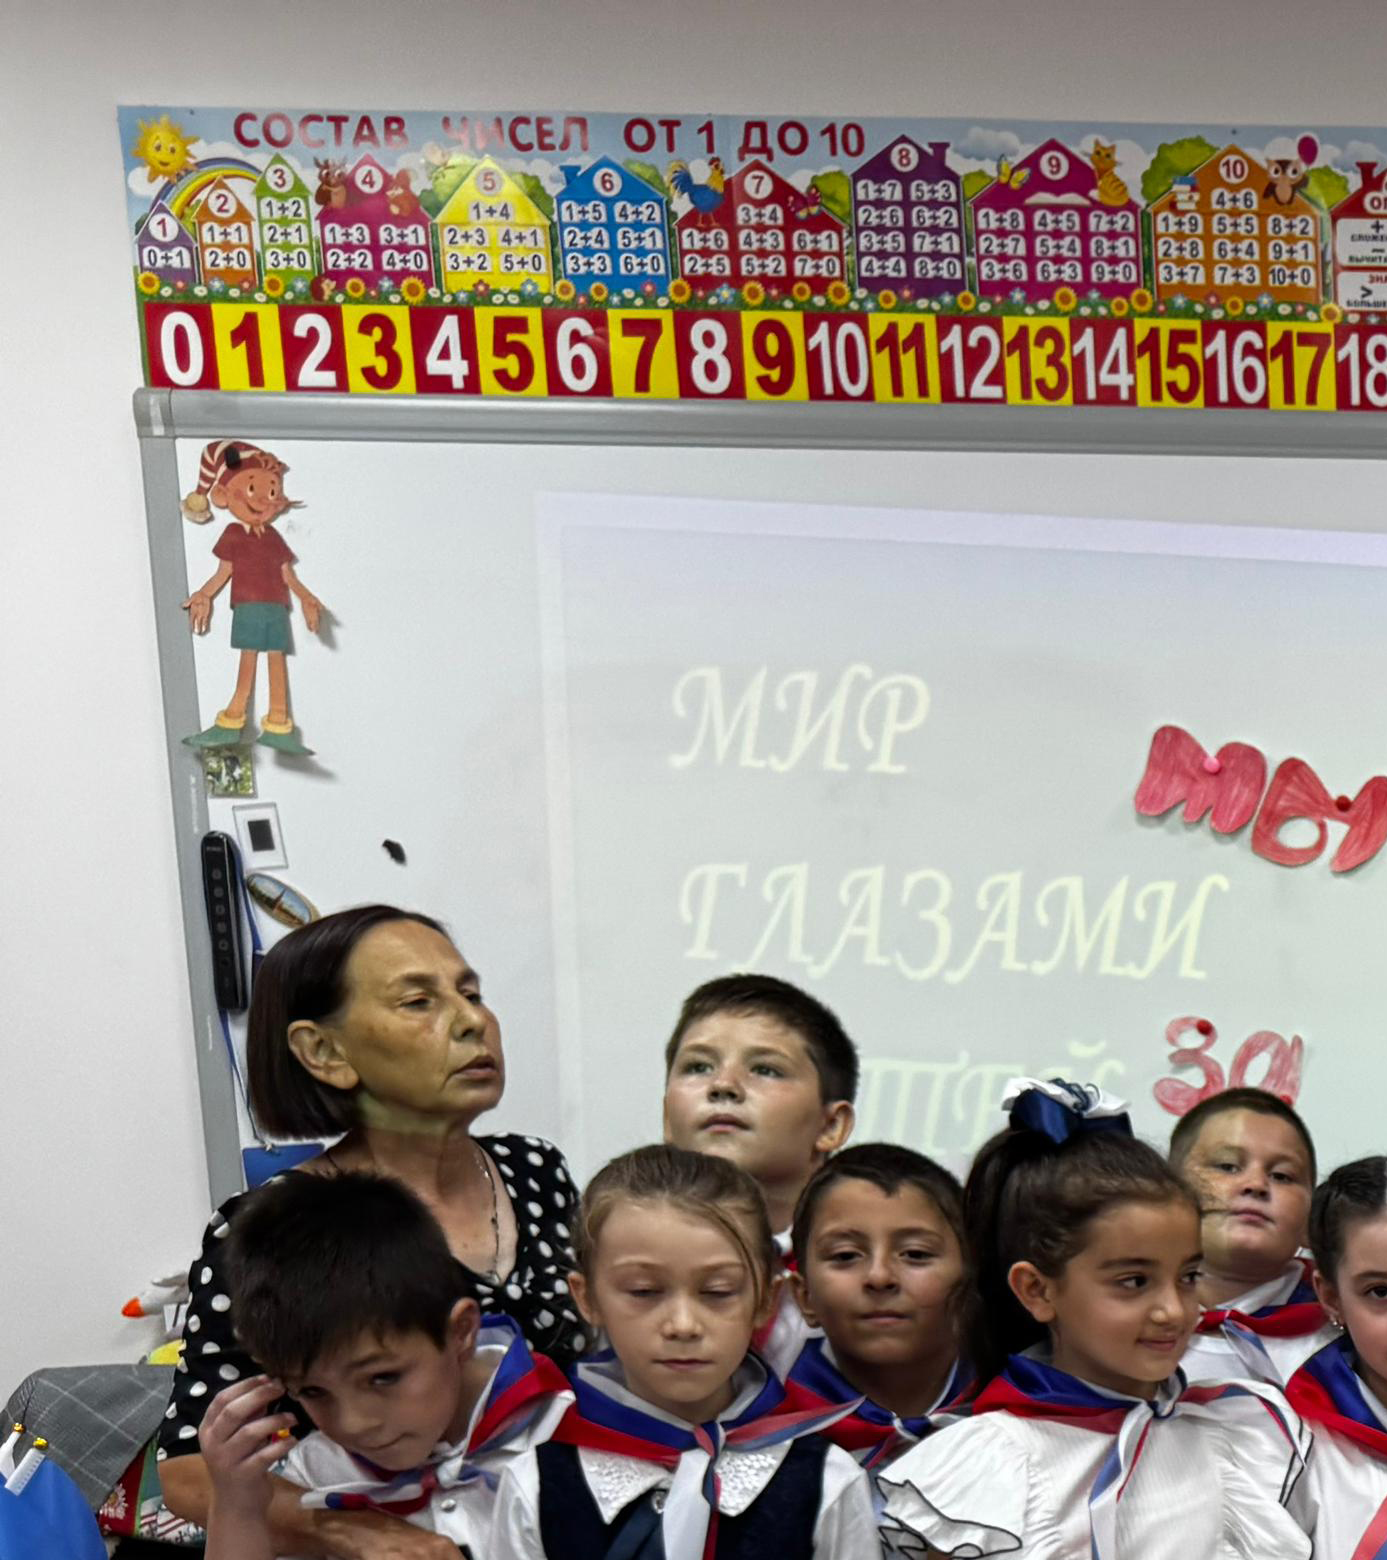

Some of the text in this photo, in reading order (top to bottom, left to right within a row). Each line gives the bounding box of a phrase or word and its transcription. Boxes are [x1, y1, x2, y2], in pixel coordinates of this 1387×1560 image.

[233, 112, 866, 158] СОСТАВ ЧИСЕЛ ОТ 1 ДО 10
[897, 148, 912, 167] 8
[1048, 152, 1062, 174] 9
[273, 168, 286, 188] 3
[362, 170, 376, 187] 4
[1220, 160, 1246, 180] 10
[482, 171, 496, 191] 5
[601, 173, 614, 192] 6
[752, 174, 765, 194] 7
[858, 182, 899, 200] 1+7
[216, 194, 229, 213] 2
[265, 200, 303, 218] 1+2
[472, 203, 511, 221] 1+4
[157, 218, 168, 237] 1
[207, 226, 247, 243] 1+1
[146, 249, 185, 268] 0+1
[1269, 267, 1313, 286] 10+0
[160, 311, 204, 387] 0
[229, 312, 262, 388] 1
[293, 313, 338, 388] 2
[360, 314, 403, 390] 3
[425, 315, 469, 390] 4
[492, 315, 535, 392] 5
[556, 317, 598, 393] 6
[622, 317, 663, 392] 7
[690, 318, 732, 394] 8
[756, 319, 798, 395] 9
[809, 321, 869, 398] 10
[875, 322, 929, 399] 11
[942, 322, 1004, 399] 12
[1007, 323, 1070, 401] 13
[1073, 325, 1134, 400] 14
[1137, 326, 1200, 404] 15
[1205, 328, 1267, 404] 16
[1270, 329, 1332, 406] 17
[667, 662, 934, 776] МИР
[679, 860, 1230, 984] ГЛАЗАМИ
